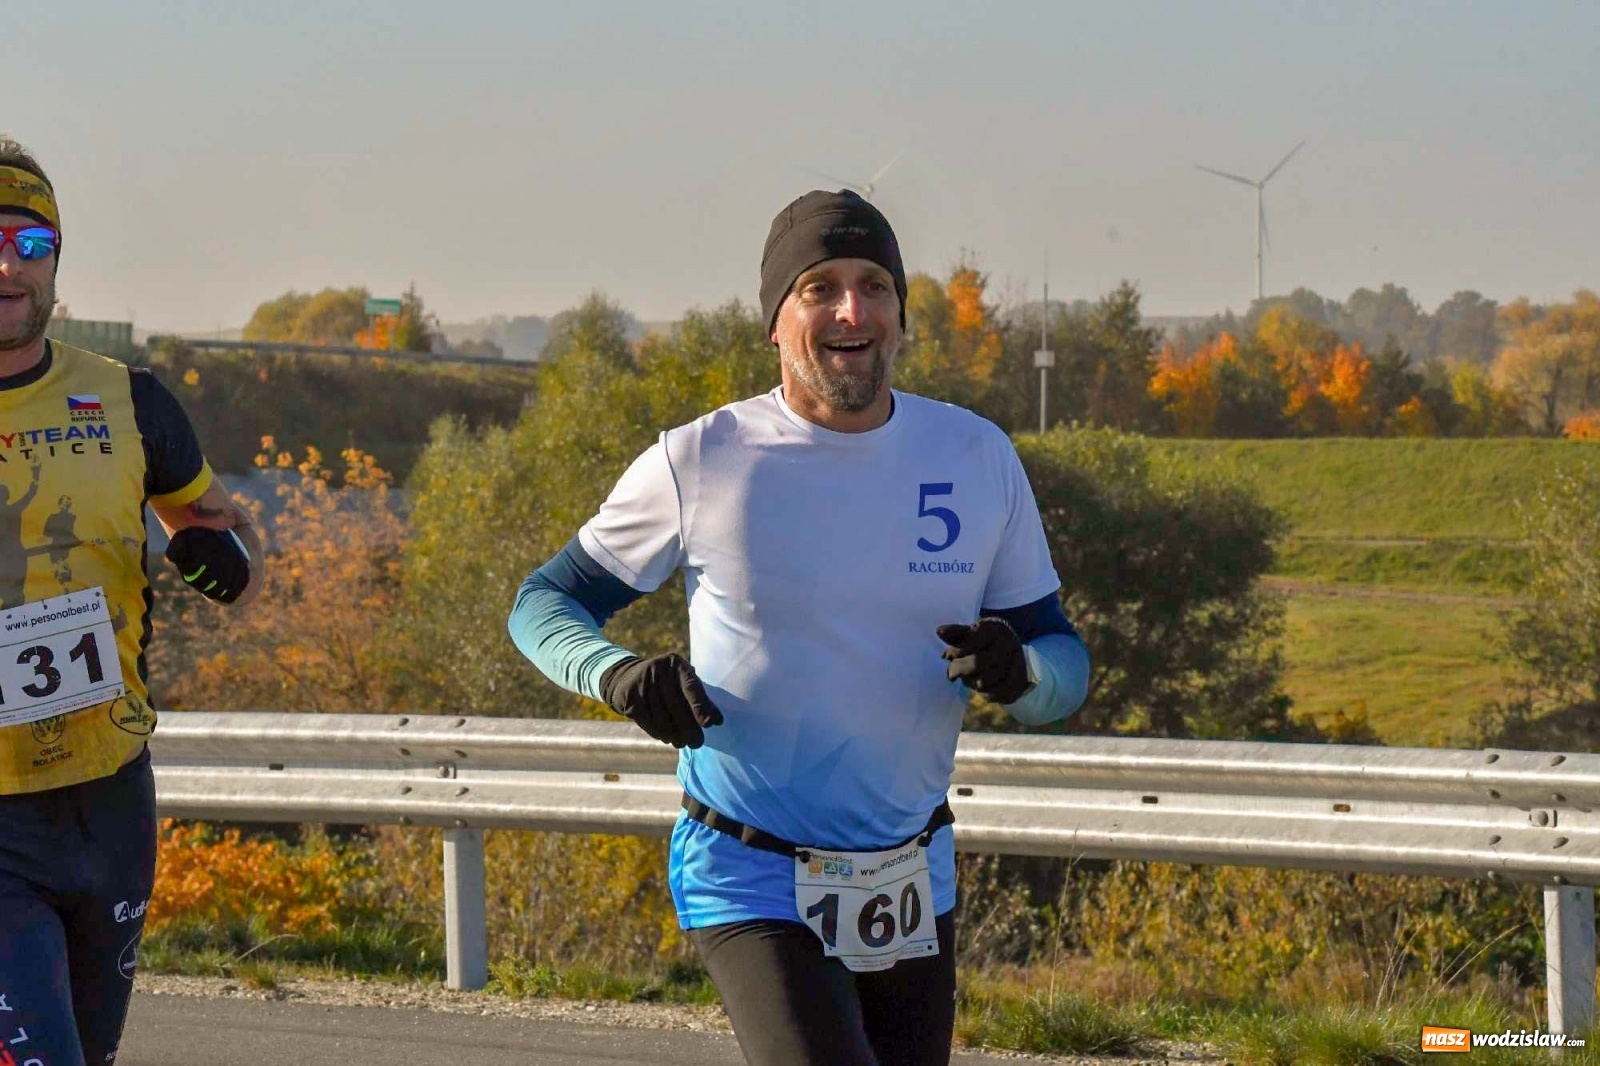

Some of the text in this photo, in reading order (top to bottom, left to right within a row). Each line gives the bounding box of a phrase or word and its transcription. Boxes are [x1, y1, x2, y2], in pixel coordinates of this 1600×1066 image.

[26, 424, 110, 445] TEAM
[917, 482, 961, 552] 5
[908, 559, 975, 573] RACIBÓRZ
[5, 600, 101, 632] www.personalbest.pl
[0, 631, 104, 705] 31
[40, 744, 64, 756] OBEC
[806, 881, 922, 949] 160
